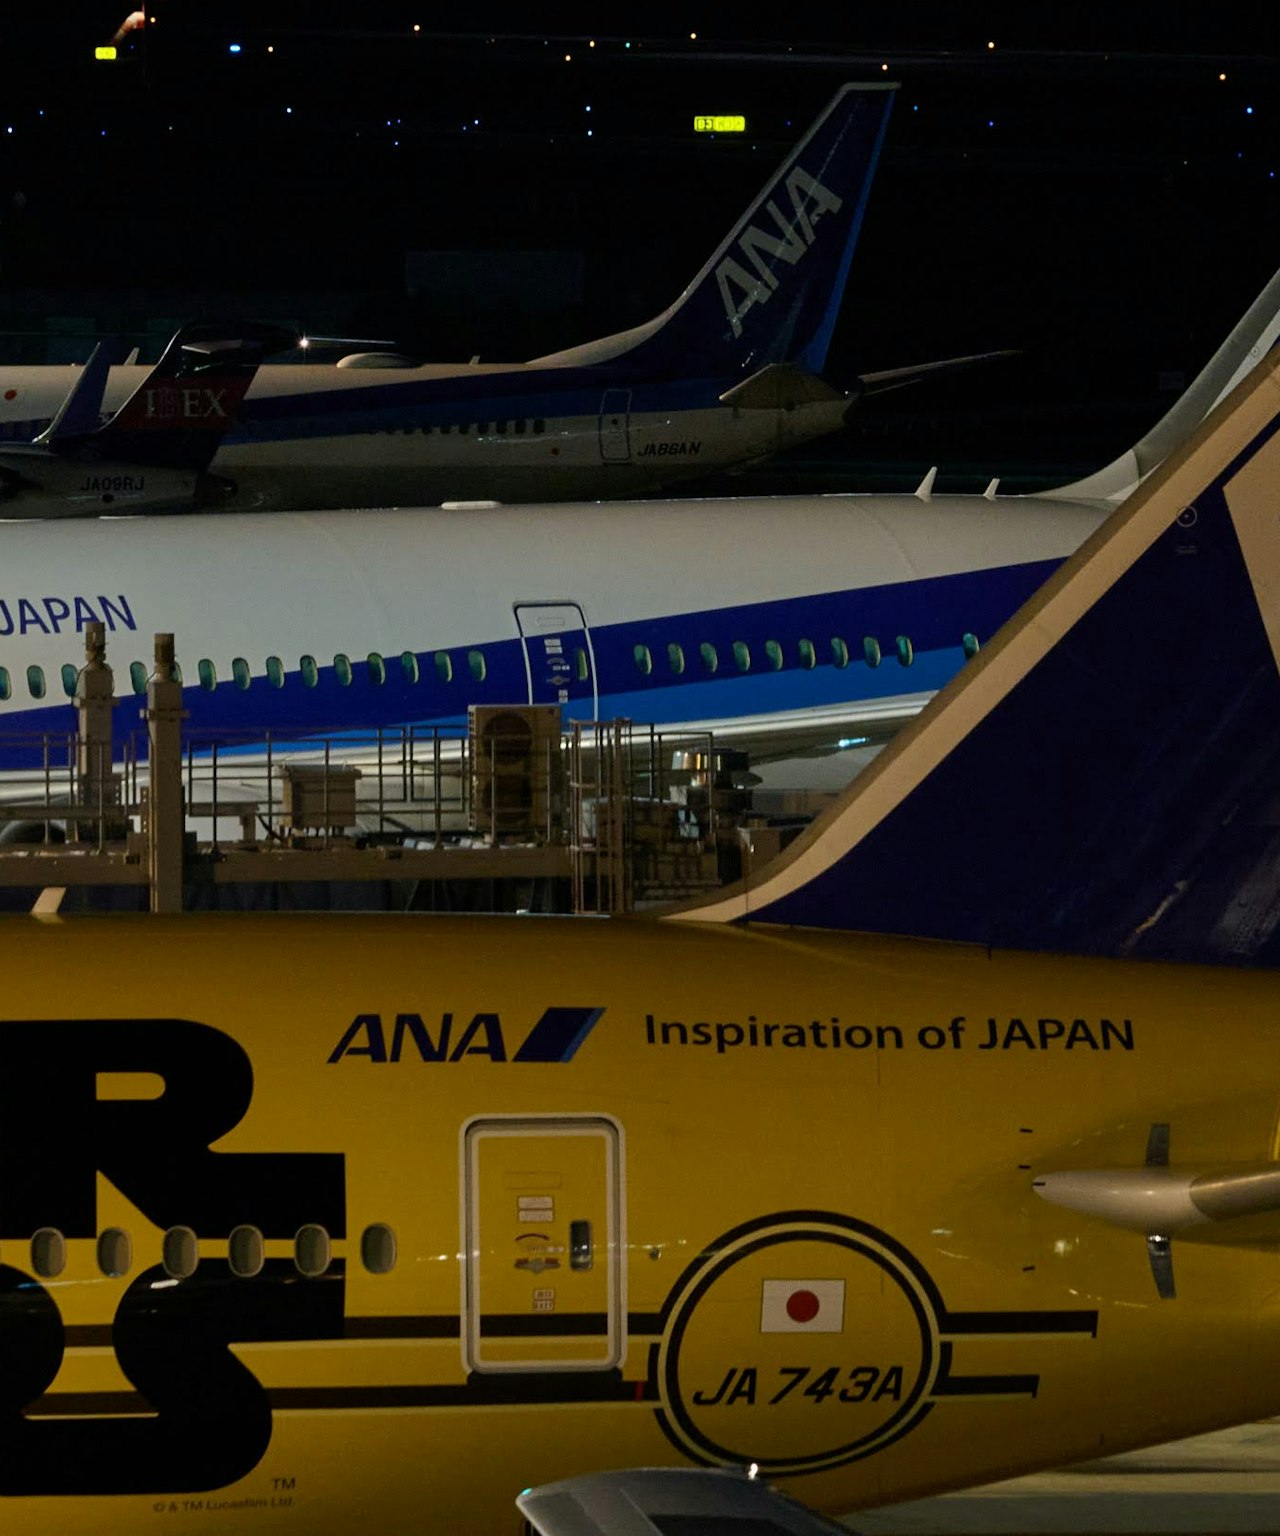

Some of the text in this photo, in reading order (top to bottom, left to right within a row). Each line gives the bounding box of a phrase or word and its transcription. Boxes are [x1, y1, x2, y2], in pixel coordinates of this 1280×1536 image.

[715, 166, 843, 338] ANA
[327, 1013, 1135, 1064] ANA Inspiration of JAPAN
[272, 1478, 296, 1491] TM
